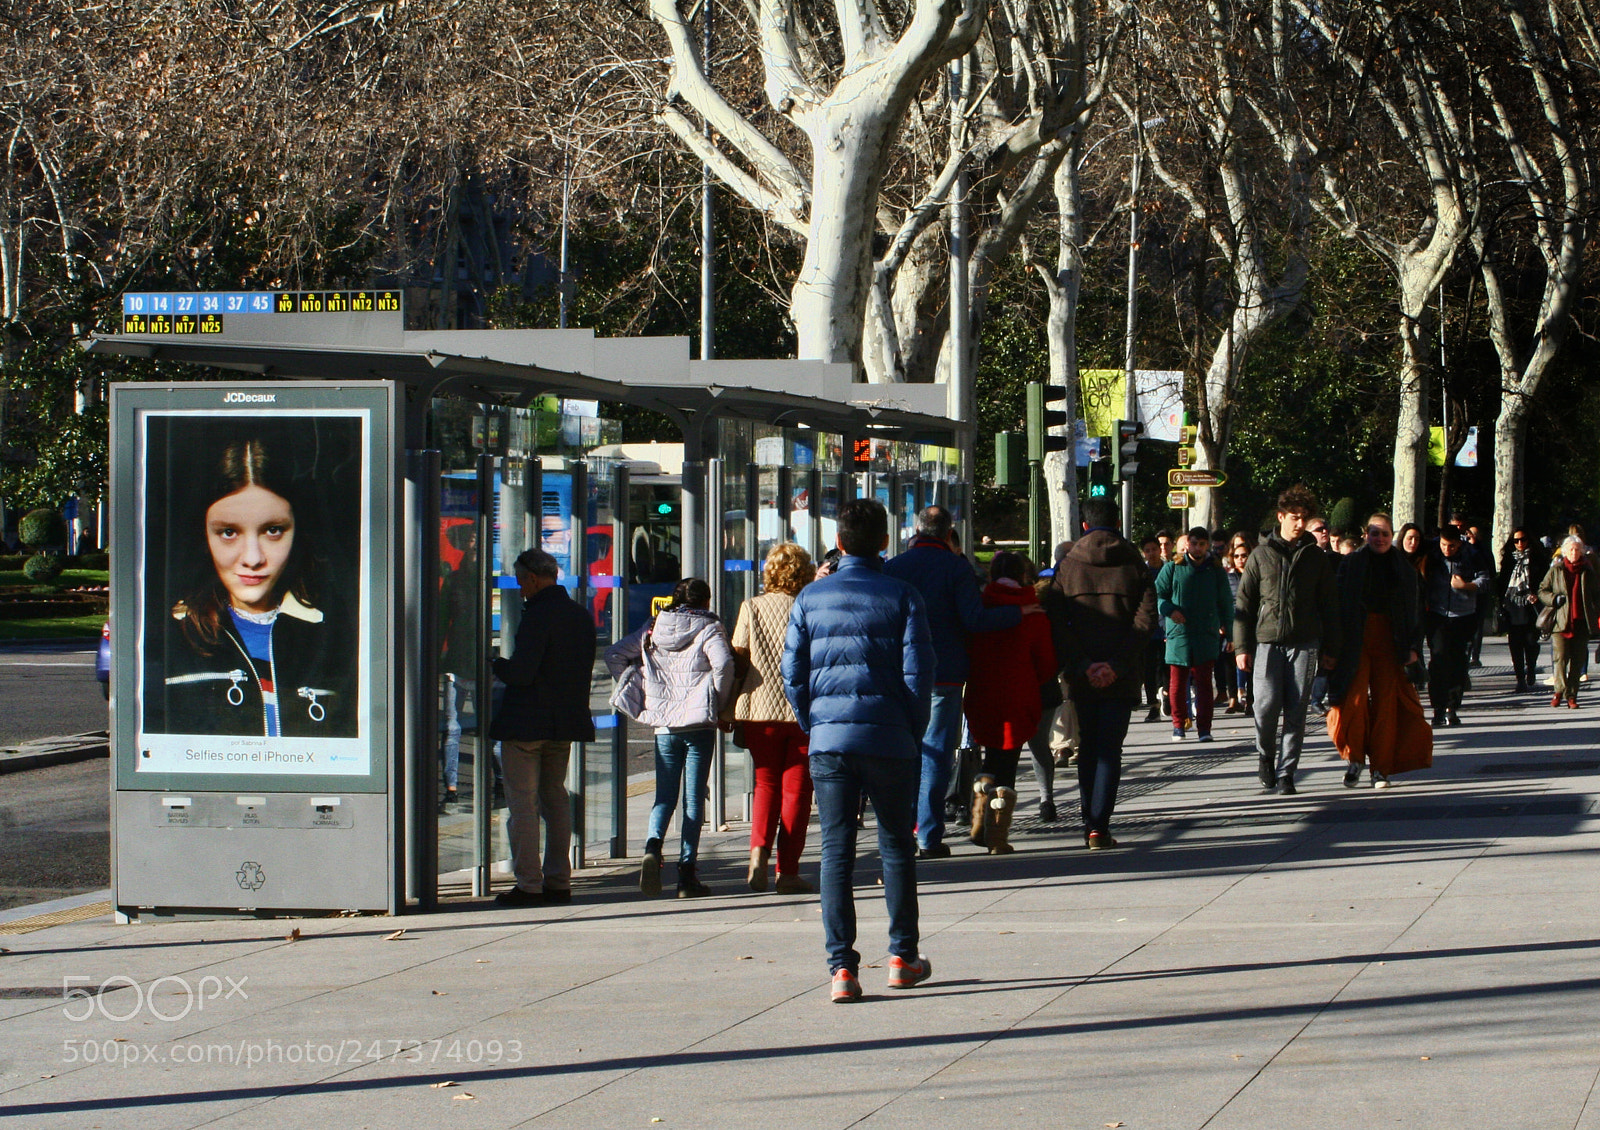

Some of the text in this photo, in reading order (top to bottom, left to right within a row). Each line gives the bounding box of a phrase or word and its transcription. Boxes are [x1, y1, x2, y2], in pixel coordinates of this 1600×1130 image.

[130, 296, 398, 312] 10 14 27 34 37 45 N9 N10 N11 N12 N13
[126, 321, 221, 333] N14 N15 N17 N25
[223, 392, 276, 403] JCDecaux
[566, 403, 580, 411] Feb
[185, 748, 314, 763] Selfies con el iPhone X
